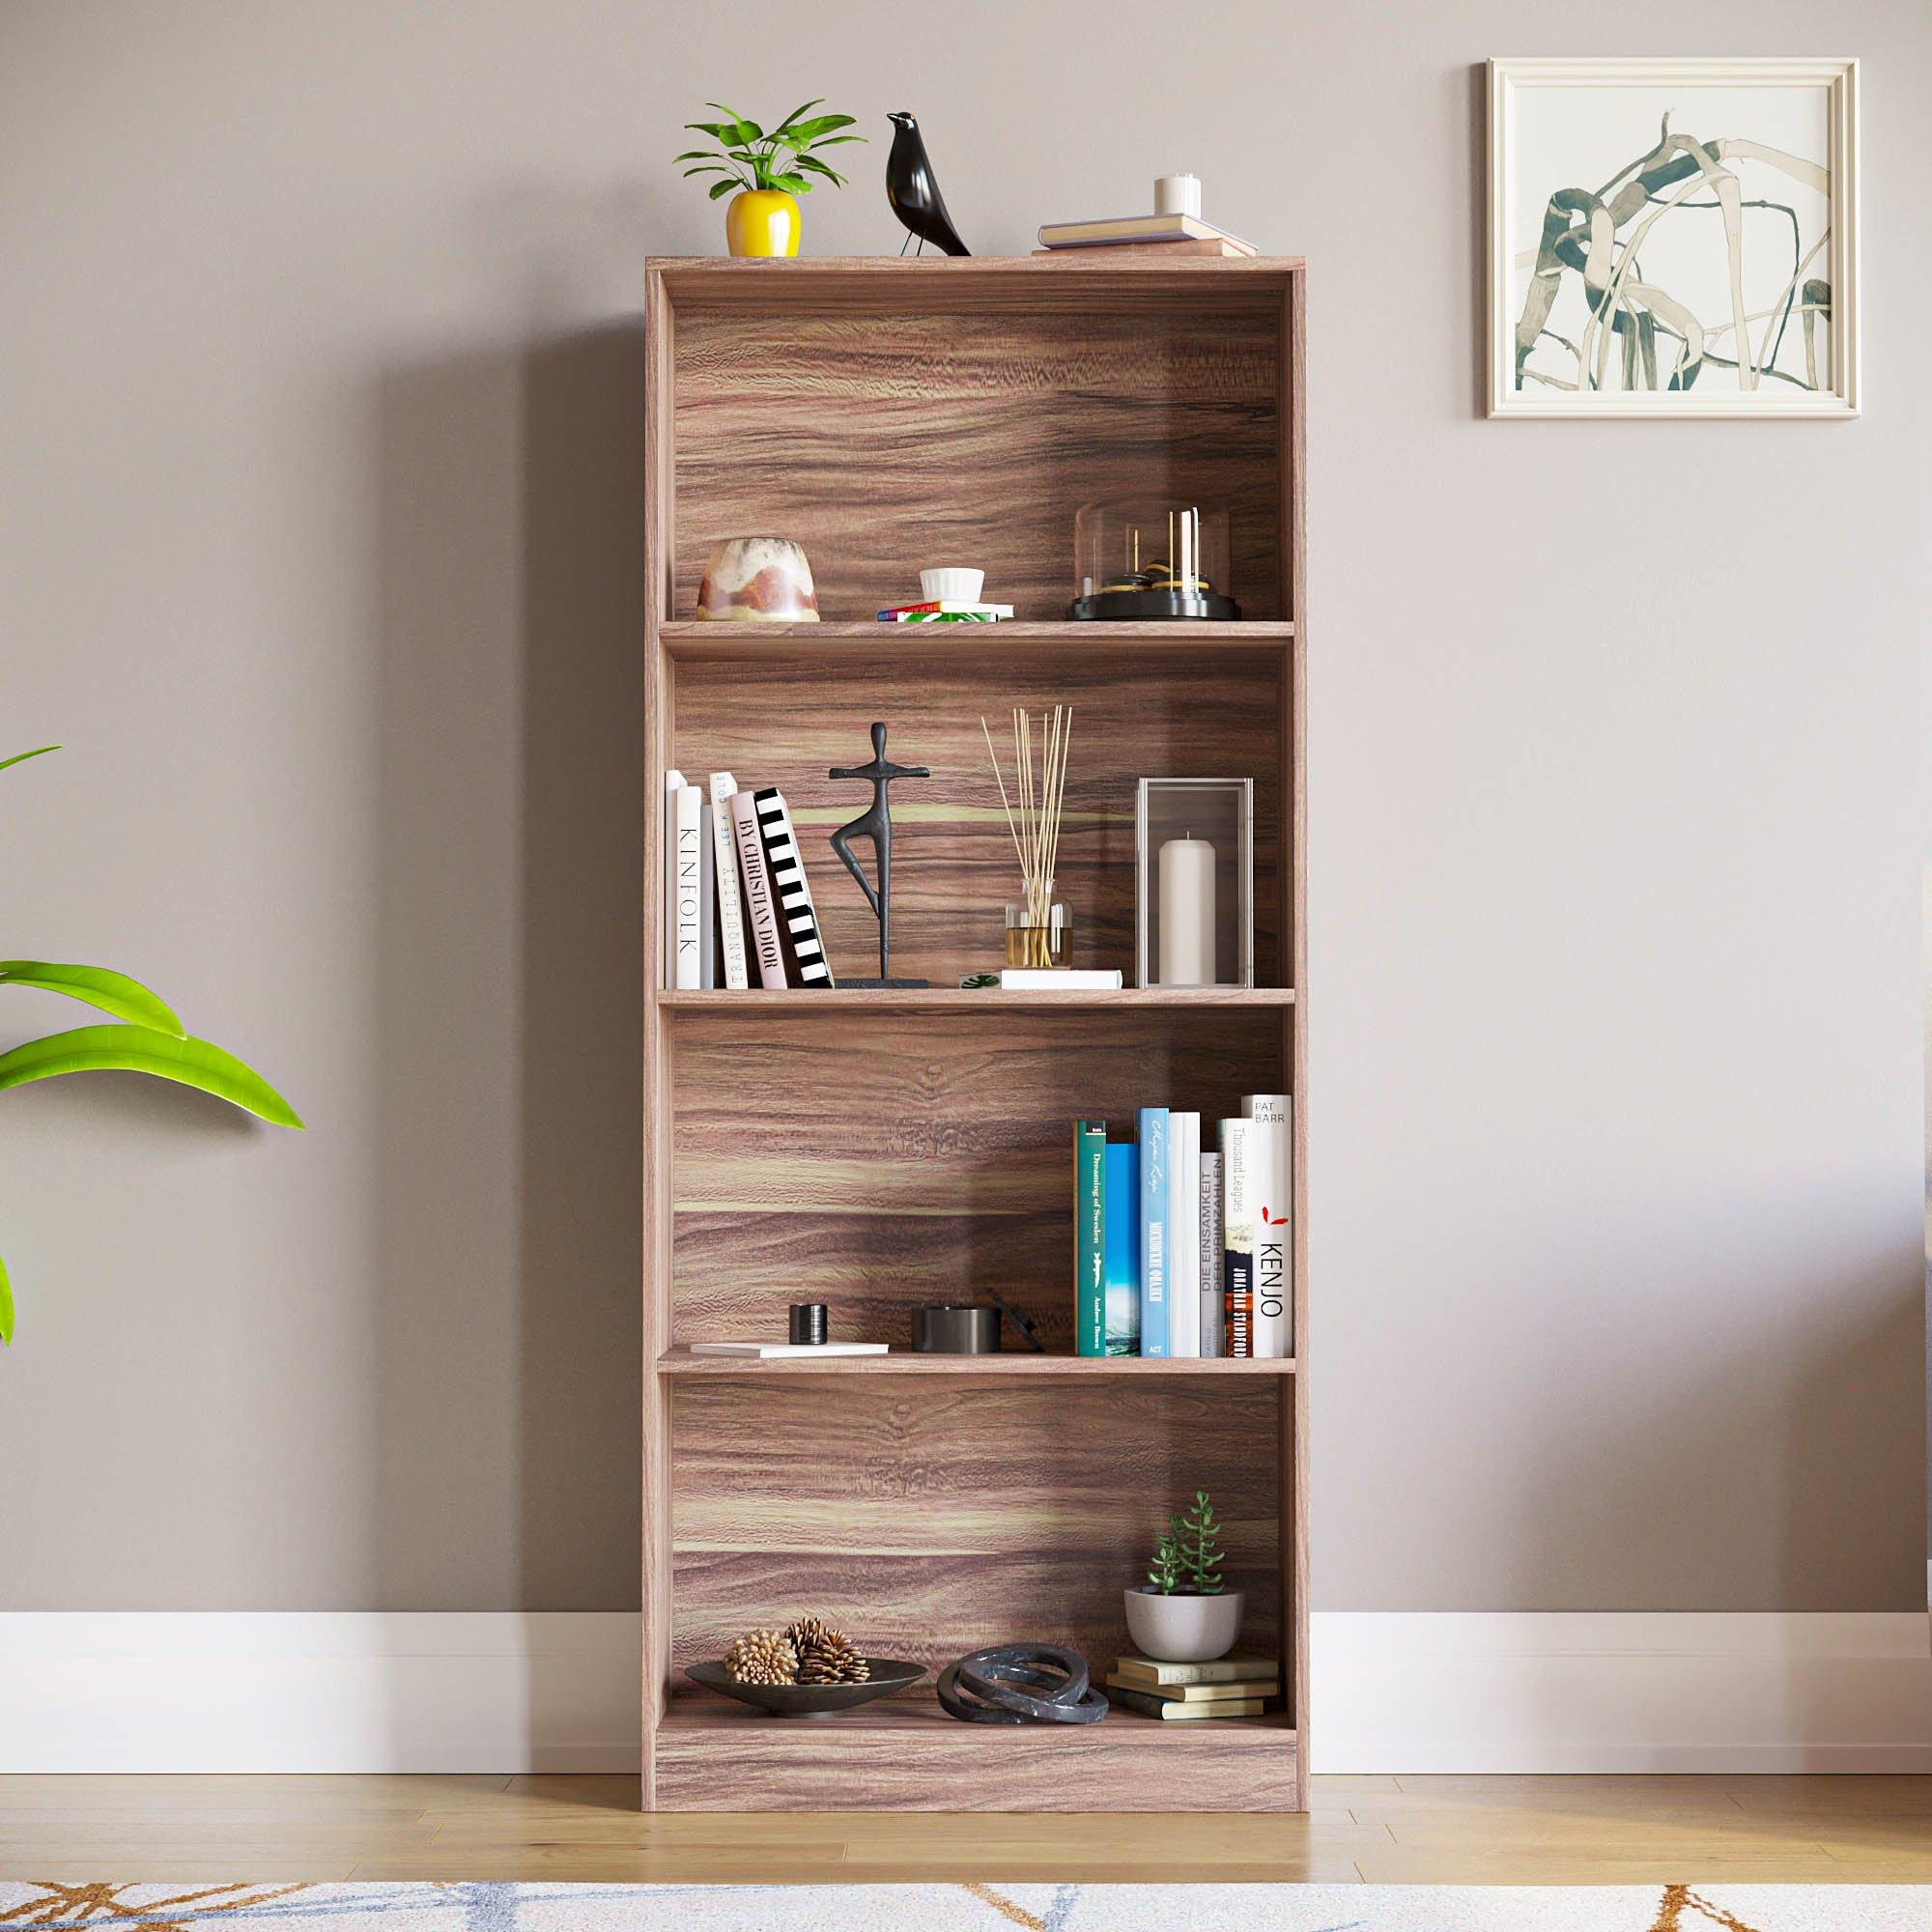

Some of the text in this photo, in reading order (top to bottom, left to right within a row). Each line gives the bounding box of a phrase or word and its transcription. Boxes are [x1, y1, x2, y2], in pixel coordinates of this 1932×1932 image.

[721, 826, 732, 846] LEE
[679, 828, 697, 953] KINFOLK
[723, 866, 743, 983] TRANQUILITY
[738, 818, 779, 970] BY CHRISTIAN DIOR
[1255, 1102, 1275, 1111] PAT
[1255, 1114, 1285, 1123] BARR
[1092, 1152, 1101, 1244] Dreaming of Sweden
[1231, 1127, 1245, 1213] Thousand Leagues
[1201, 1171, 1211, 1293] DIE EINSAMKEIT
[1212, 1158, 1222, 1293] DER PRIMZAHLEN
[1094, 1296, 1102, 1324] Andrew
[1233, 1267, 1247, 1358] JONATHAN STANDFORD
[1260, 1243, 1283, 1318] KENJO
